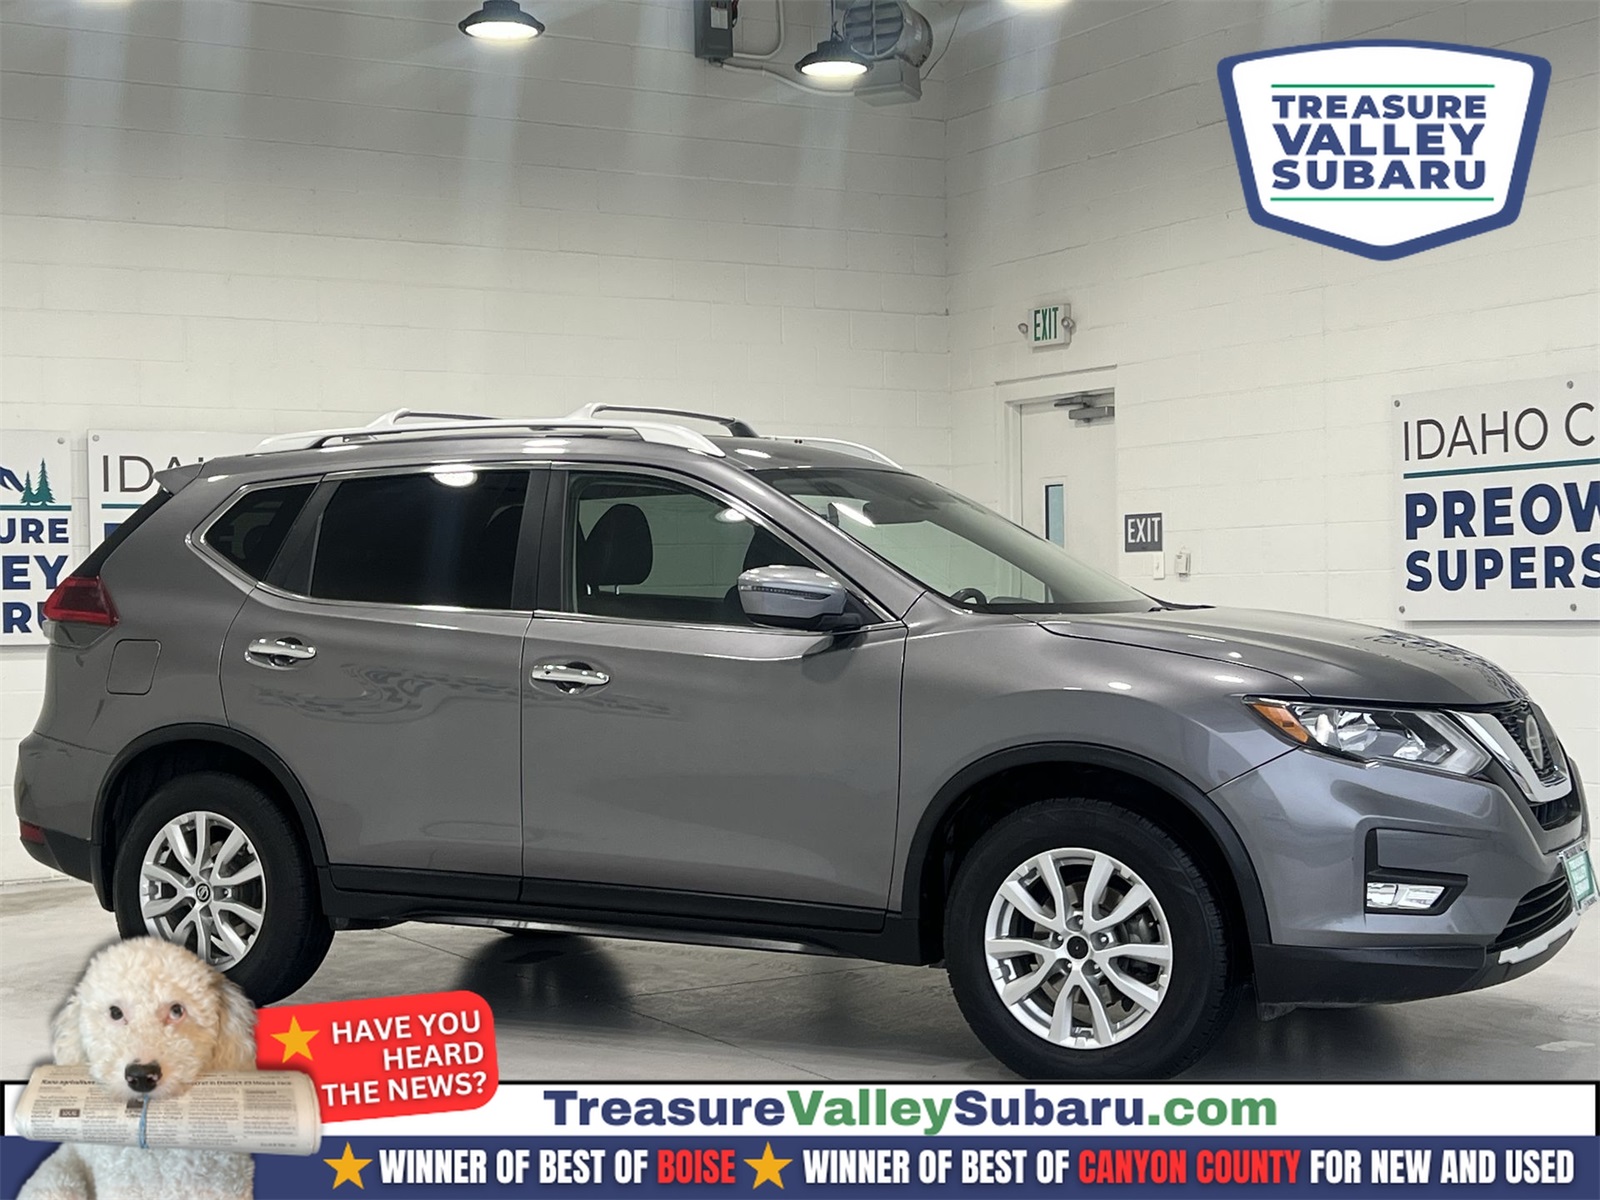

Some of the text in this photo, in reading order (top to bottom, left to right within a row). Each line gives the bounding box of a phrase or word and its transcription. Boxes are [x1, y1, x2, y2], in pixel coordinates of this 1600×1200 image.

[1033, 306, 1059, 342] EXIT
[1403, 407, 1549, 462] IDAHO
[1127, 516, 1161, 544] EXIT
